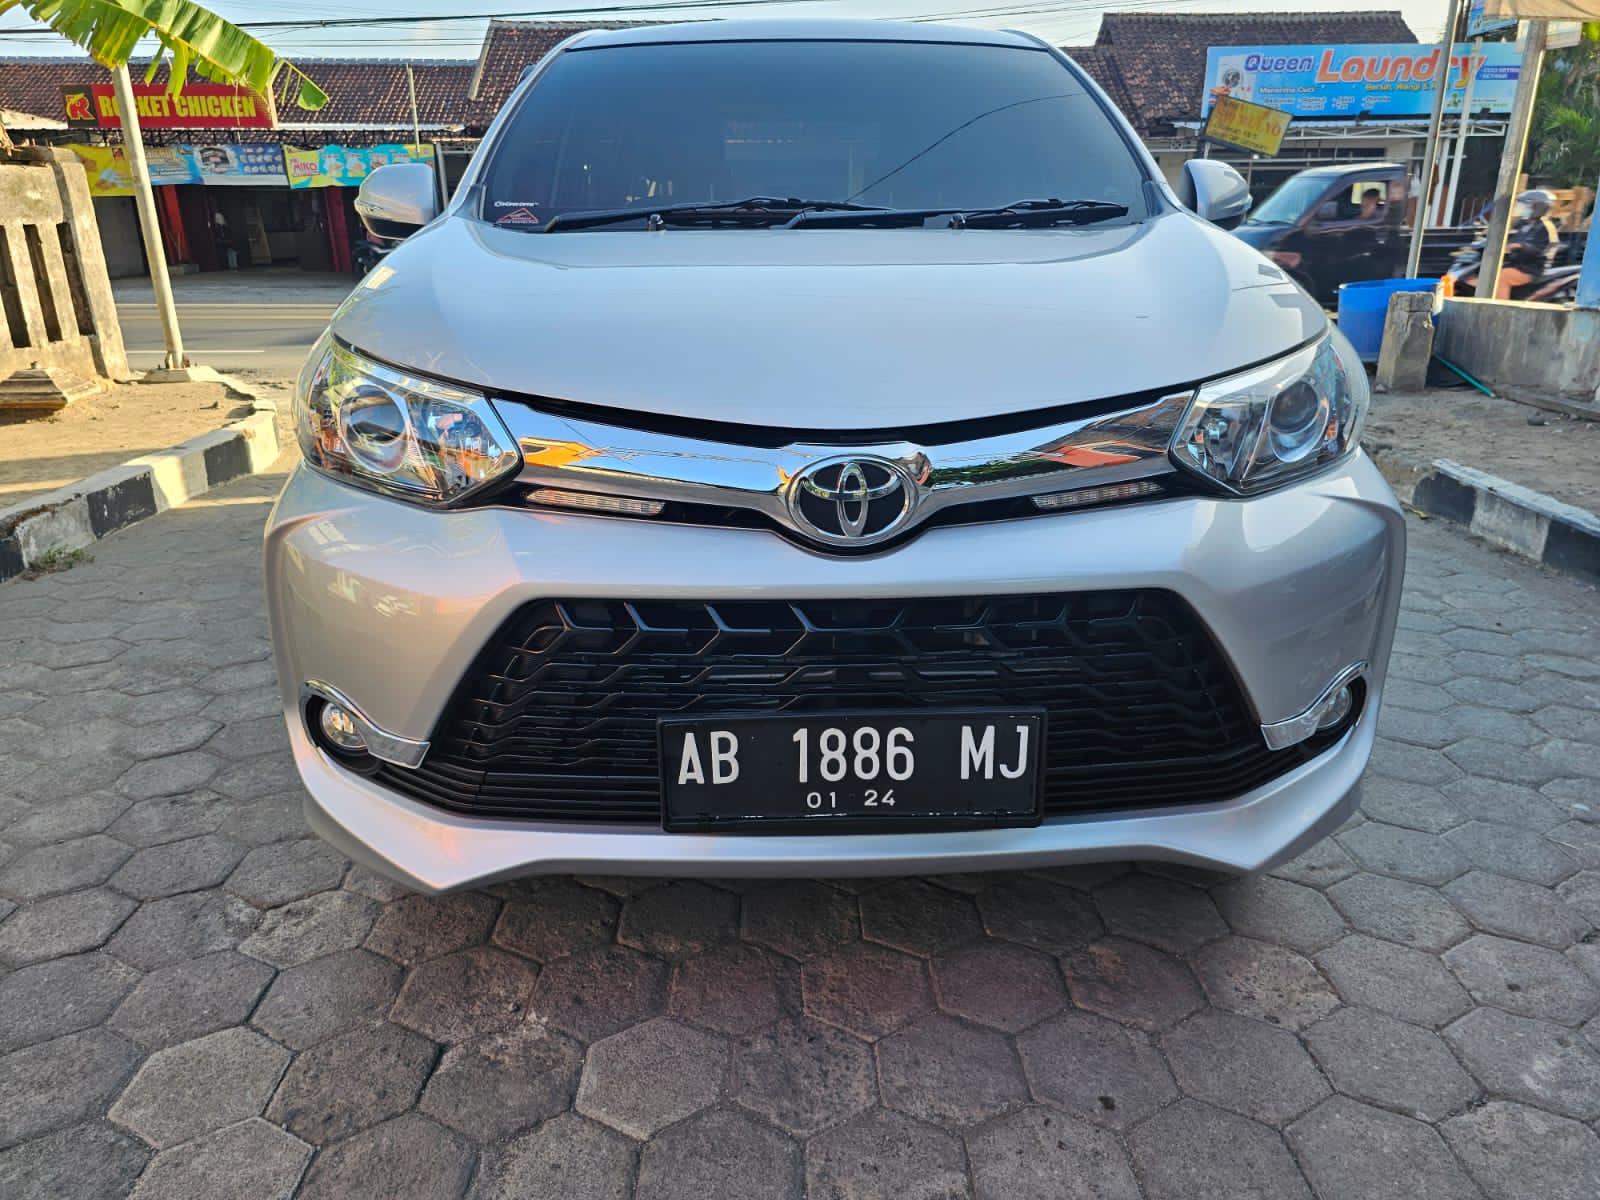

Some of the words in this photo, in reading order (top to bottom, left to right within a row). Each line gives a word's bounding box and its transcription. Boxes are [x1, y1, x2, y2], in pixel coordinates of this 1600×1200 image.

[1244, 54, 1314, 73] Queen
[98, 95, 171, 118] ROKET
[174, 95, 257, 118] CHICKEN
[677, 730, 740, 785] AB
[792, 726, 915, 783] 1886
[960, 724, 1030, 780] MJ
[806, 791, 837, 809] 01
[864, 789, 897, 807] 24
